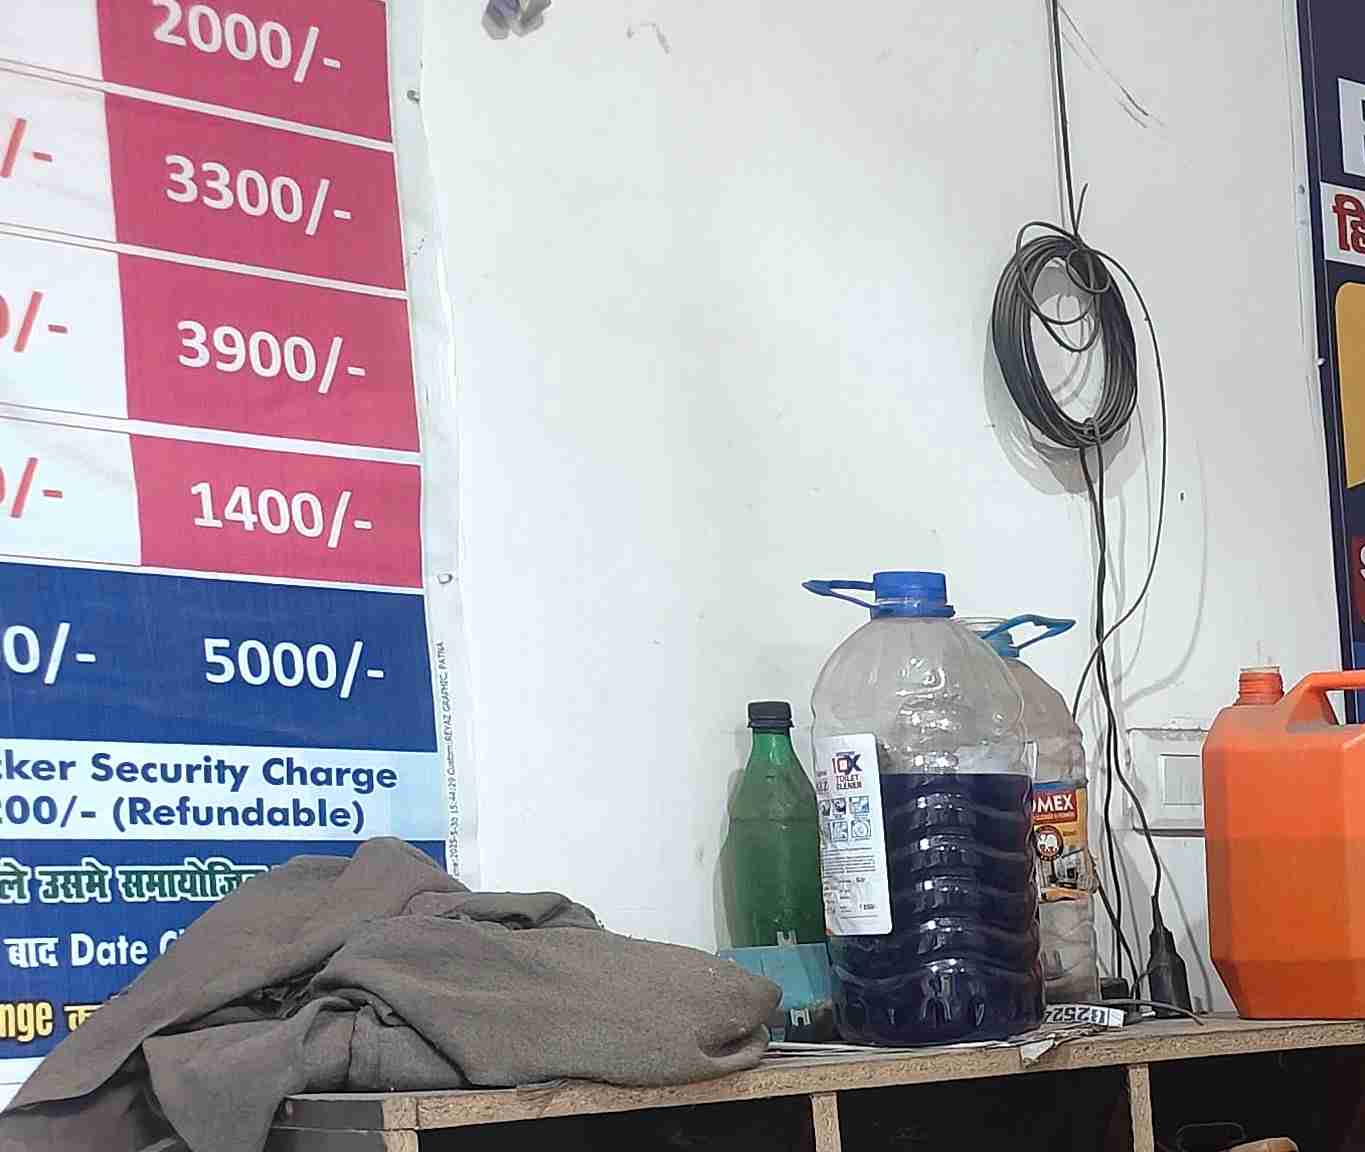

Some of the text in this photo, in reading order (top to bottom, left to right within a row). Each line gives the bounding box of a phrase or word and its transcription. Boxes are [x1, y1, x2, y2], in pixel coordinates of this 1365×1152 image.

[152, 0, 341, 82] 2000/-
[164, 154, 352, 235] 3300/-
[176, 319, 366, 393] 3900/-
[190, 481, 372, 548] 1400/-
[203, 637, 385, 699] 5000/-
[0, 749, 398, 794] ker Security Charge
[0, 795, 365, 833] 00/- (Refundable)
[4, 937, 58, 968] बाद
[70, 933, 148, 966] Date
